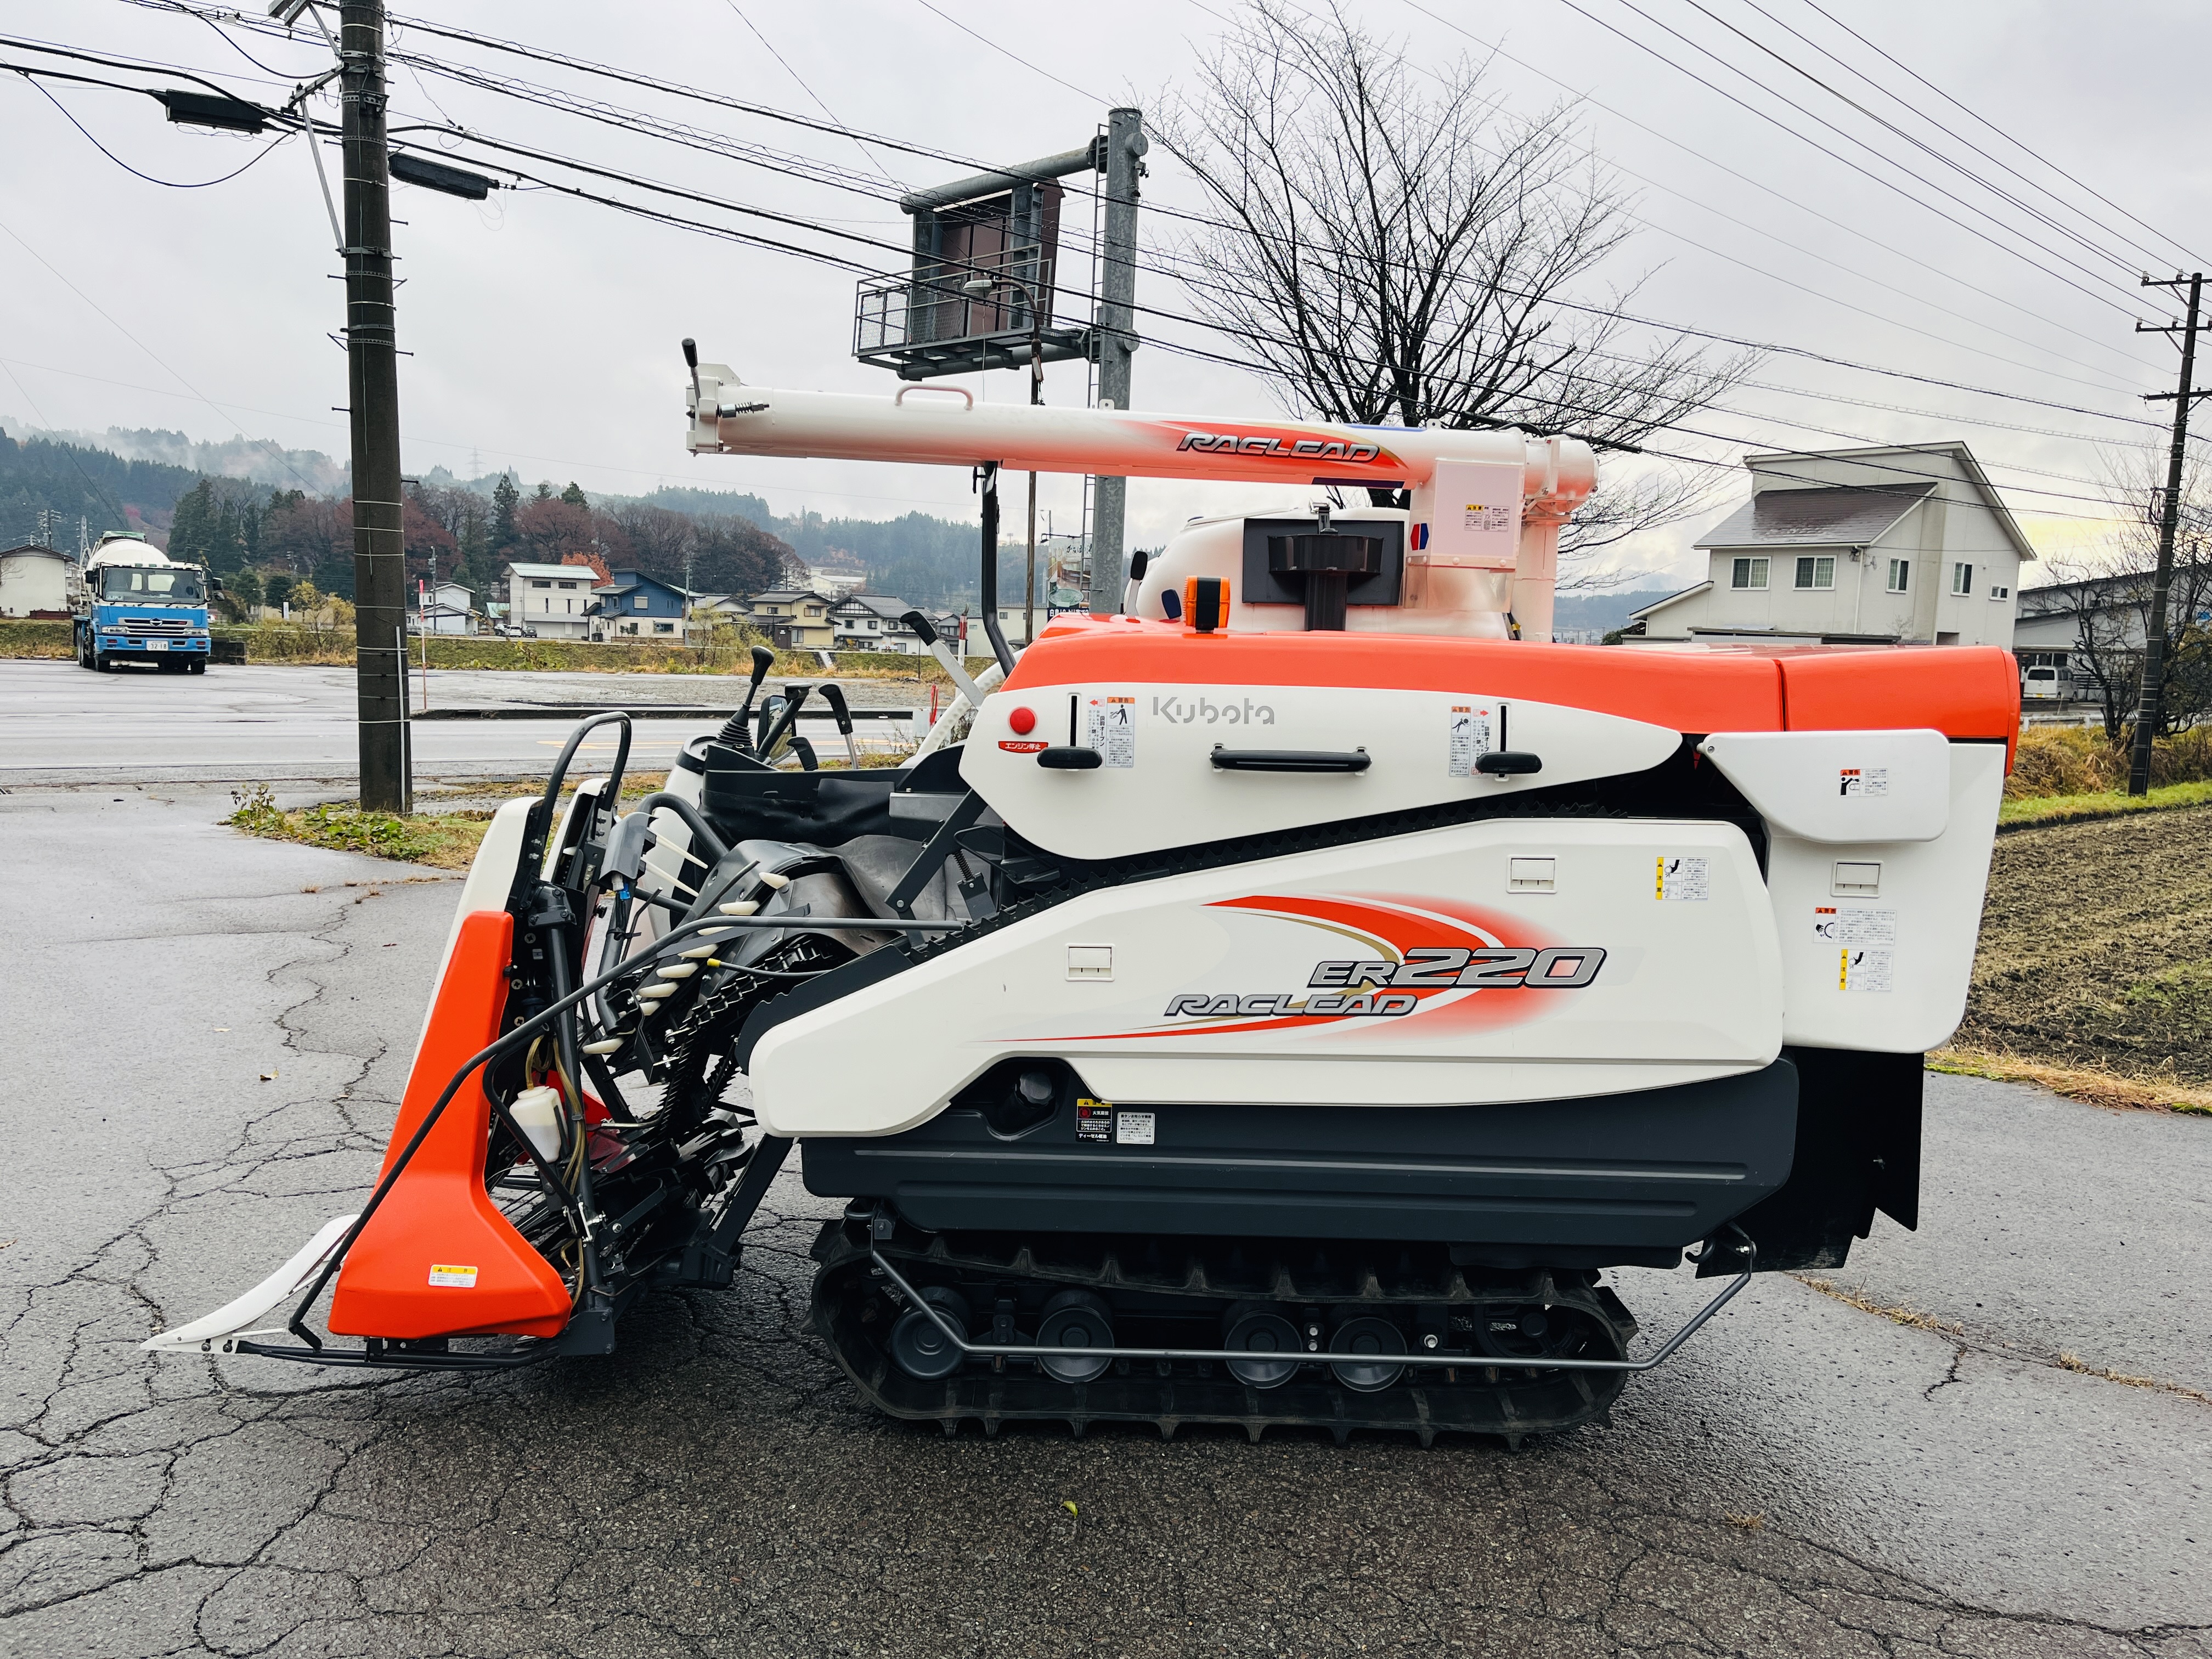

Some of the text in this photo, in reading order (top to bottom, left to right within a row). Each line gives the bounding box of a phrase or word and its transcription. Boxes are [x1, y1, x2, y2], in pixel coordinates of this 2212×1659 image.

[1177, 432, 1380, 462] RACLEAD
[1153, 697, 1275, 725] Kubota
[1164, 994, 1418, 1016] RACLEAD
